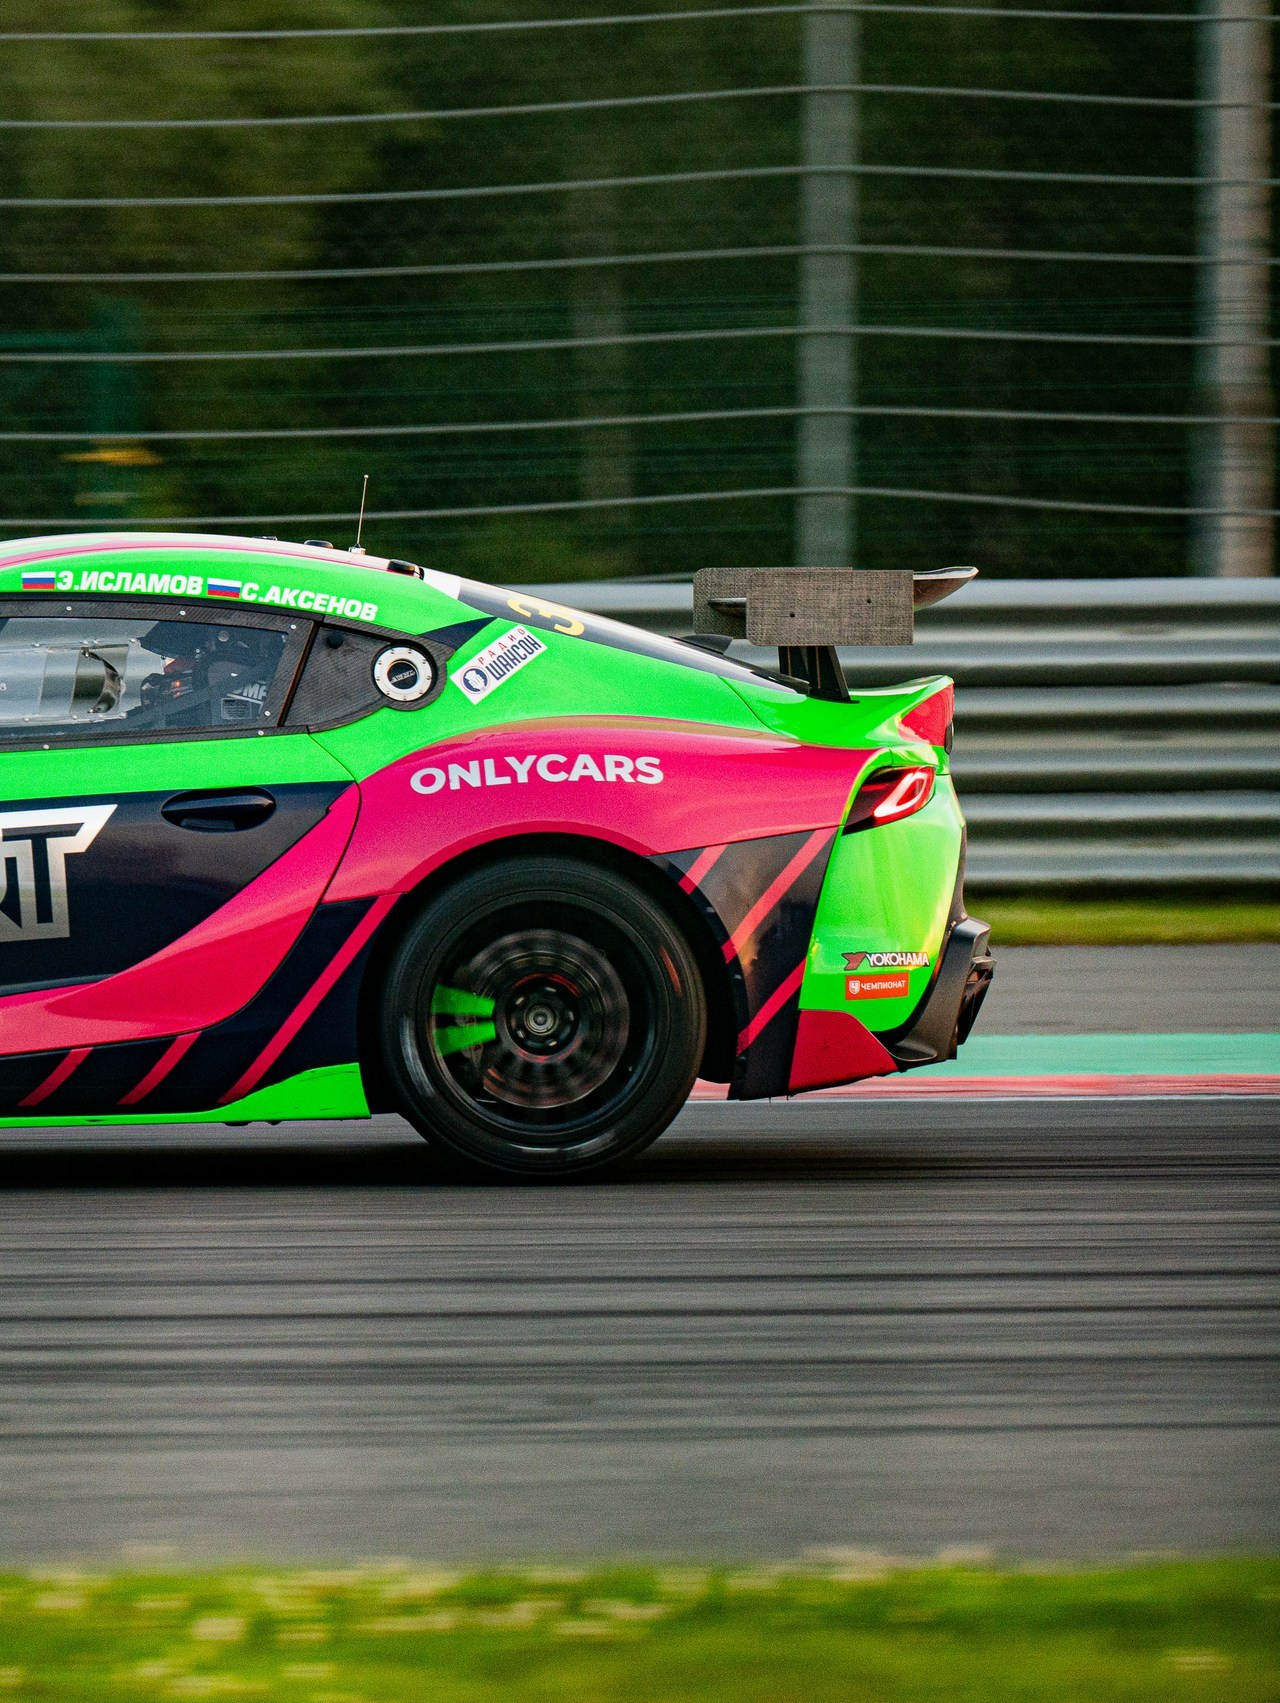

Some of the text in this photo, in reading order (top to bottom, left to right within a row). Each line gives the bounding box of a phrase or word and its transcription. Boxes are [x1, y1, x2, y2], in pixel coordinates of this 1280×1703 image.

[56, 570, 379, 622] Э.ИСЛАМОВ С.АКСЕНОВ
[477, 628, 526, 665] РАДИО
[485, 634, 542, 681] ШАНСОН
[409, 753, 664, 795] ONLYCARS
[865, 952, 930, 967] YOKOHAMA
[861, 980, 906, 991] ЧЕМПИОНАТ
